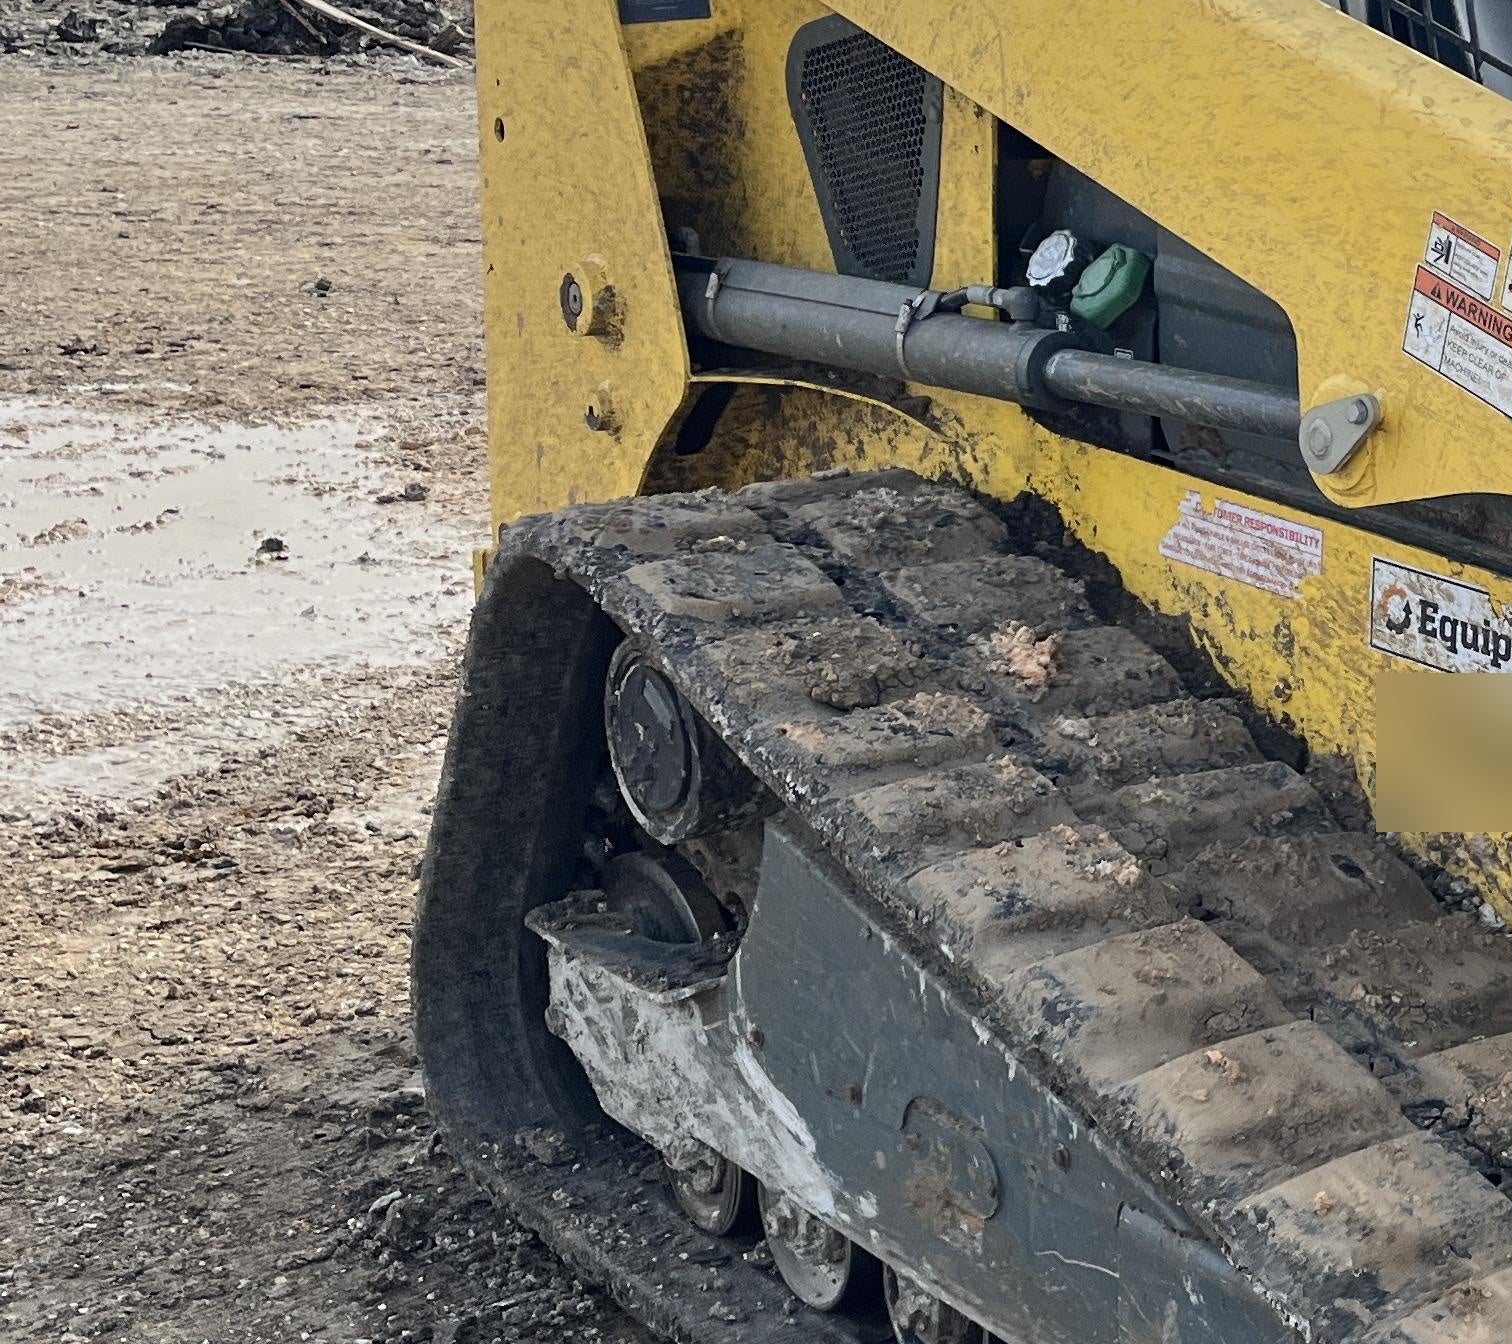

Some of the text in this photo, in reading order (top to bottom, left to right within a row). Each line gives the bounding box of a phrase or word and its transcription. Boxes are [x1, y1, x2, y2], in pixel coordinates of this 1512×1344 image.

[1447, 339, 1468, 360] KEEP
[1468, 353, 1495, 376] CLEAR
[1193, 501, 1320, 549] CTOMER RESPONSIBILITY
